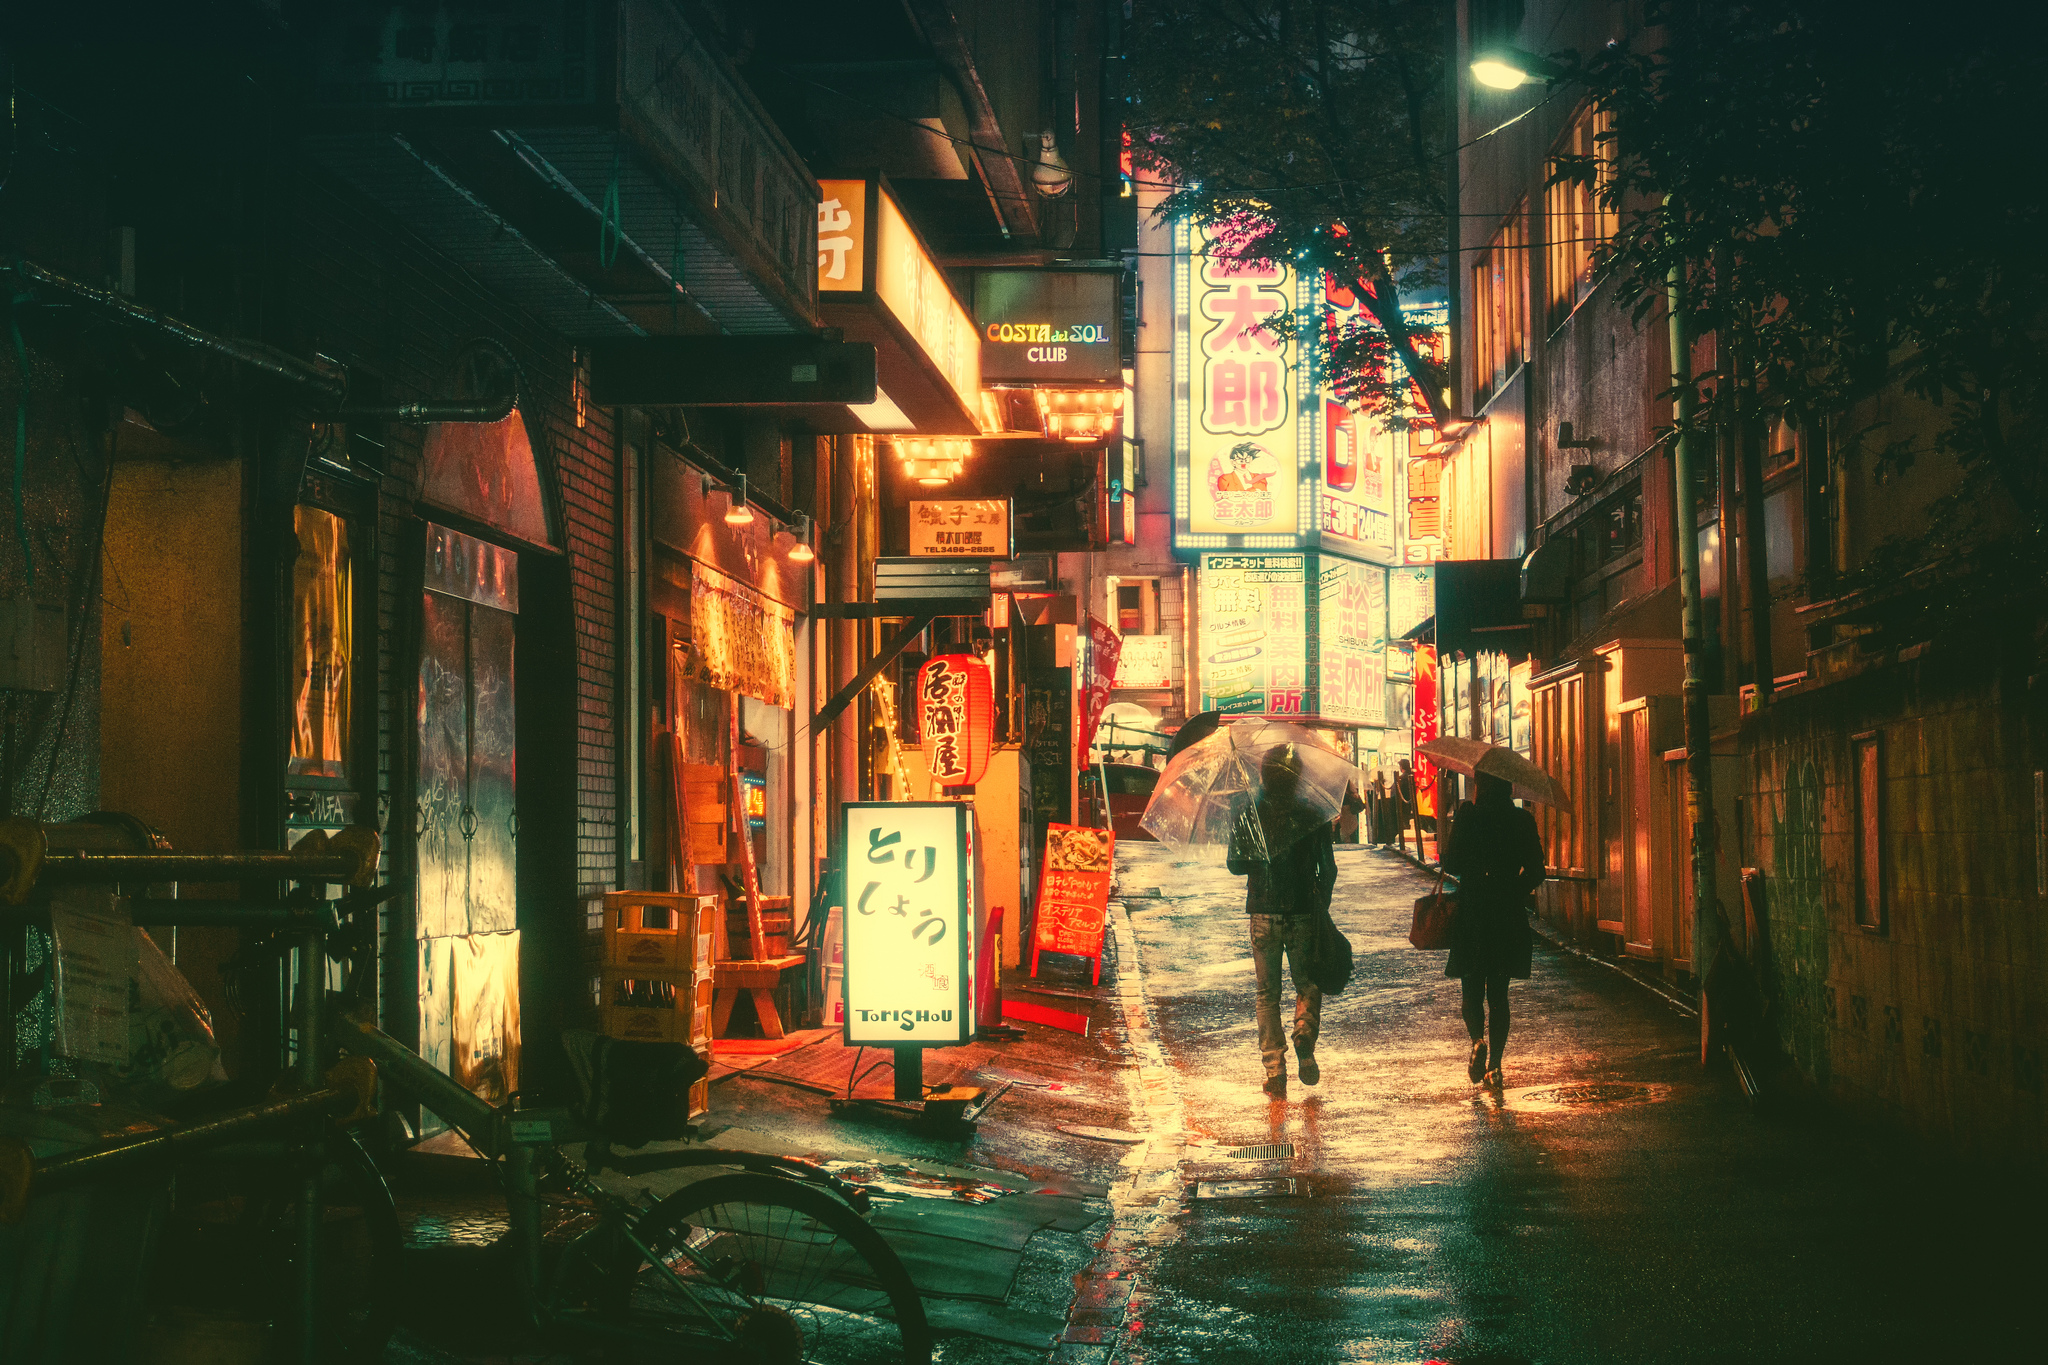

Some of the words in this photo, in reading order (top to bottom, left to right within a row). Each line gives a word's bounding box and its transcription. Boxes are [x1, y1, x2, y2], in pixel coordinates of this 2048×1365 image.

[986, 323, 1051, 343] COSTA
[1051, 329, 1069, 343] del
[1069, 324, 1110, 343] SOL
[1026, 346, 1068, 363] CLUB
[1111, 478, 1122, 503] 2
[1216, 499, 1273, 518] 金太郎
[1332, 498, 1358, 540] 3F
[1208, 575, 1240, 589] すべて
[1214, 587, 1262, 613] 無料
[1338, 579, 1370, 640] 渋谷
[1269, 585, 1302, 713] 無料案内所
[1338, 635, 1370, 647] SHIBUYA
[1323, 646, 1384, 711] 案内所
[923, 660, 967, 779] 居酒屋
[867, 827, 938, 884] とり
[856, 880, 947, 947] しょう
[1041, 903, 1084, 918] オステリア
[1067, 917, 1101, 930] アマルゴ
